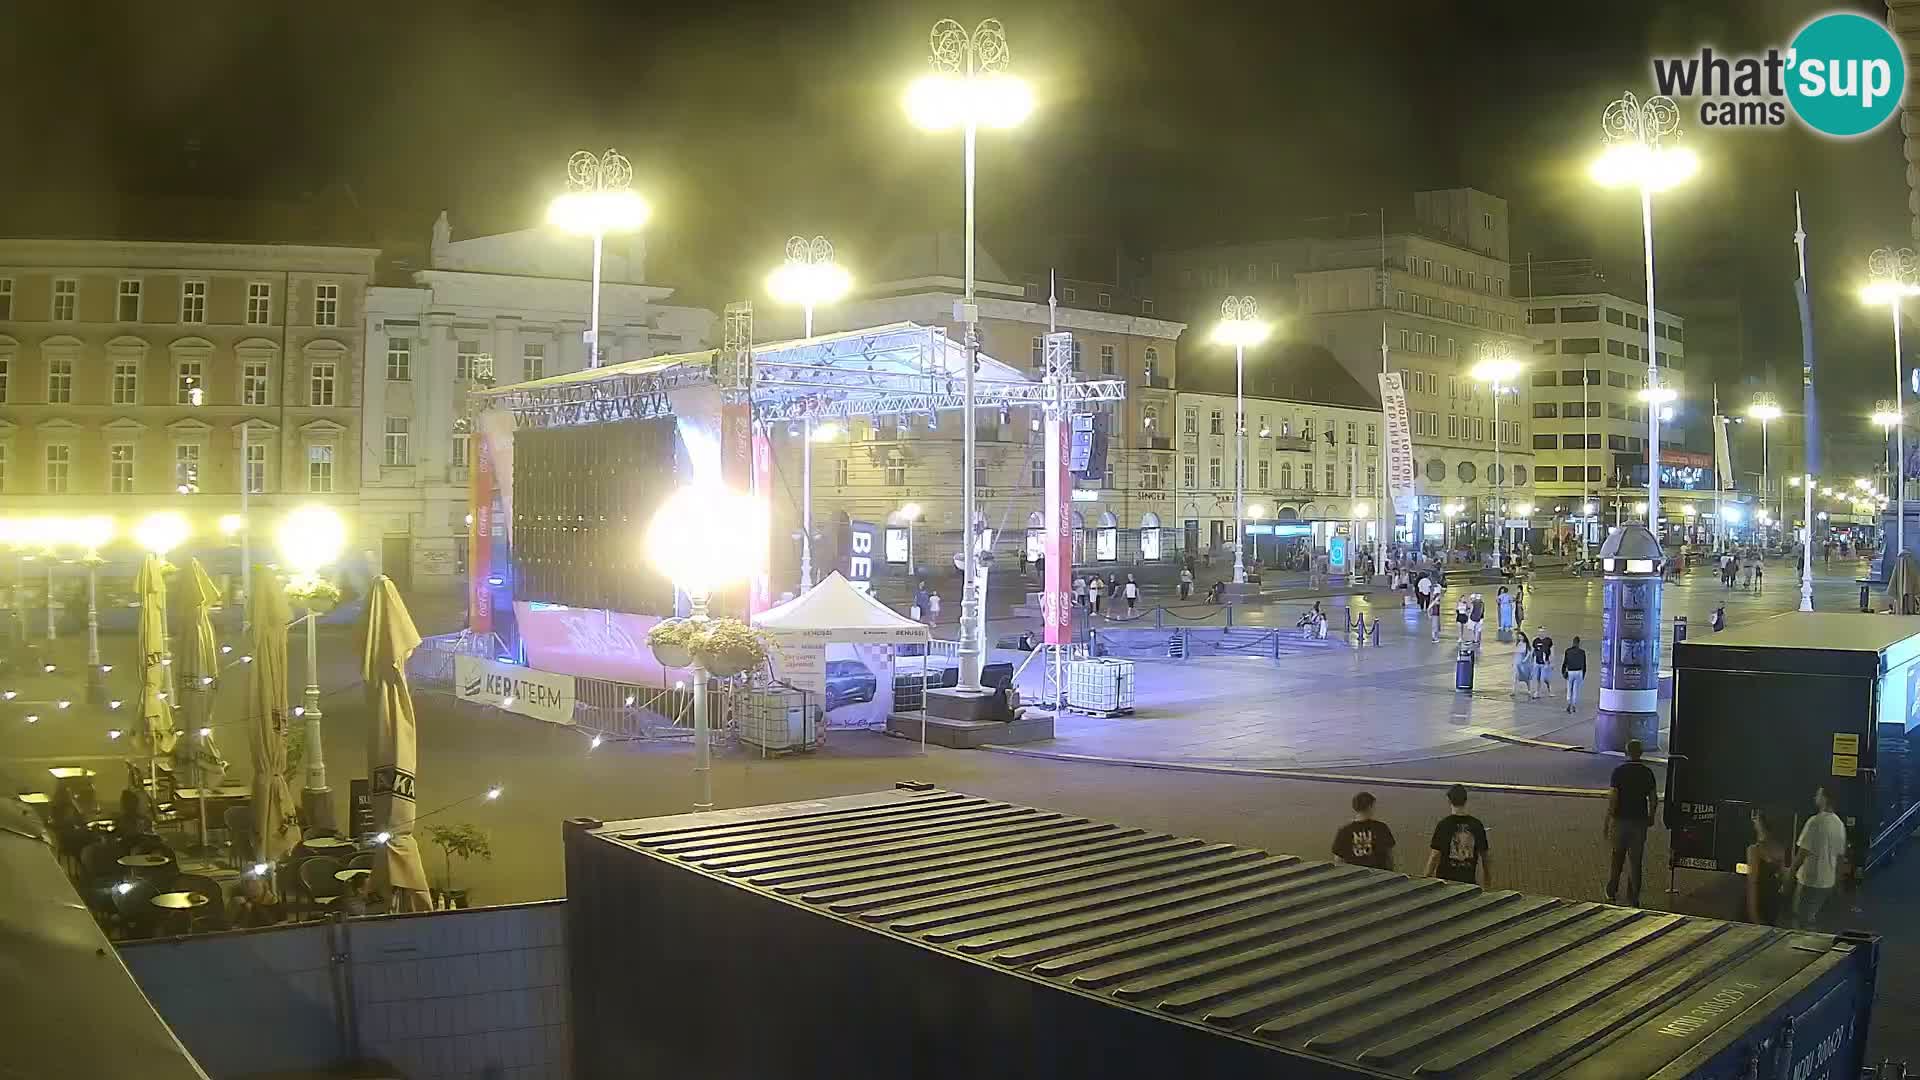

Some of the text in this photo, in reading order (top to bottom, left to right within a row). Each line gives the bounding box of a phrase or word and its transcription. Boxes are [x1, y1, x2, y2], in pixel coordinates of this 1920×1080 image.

[1060, 502, 1069, 537] Coca-Cola
[1060, 591, 1069, 626] Coca-Cola
[486, 673, 561, 709] KERATERM
